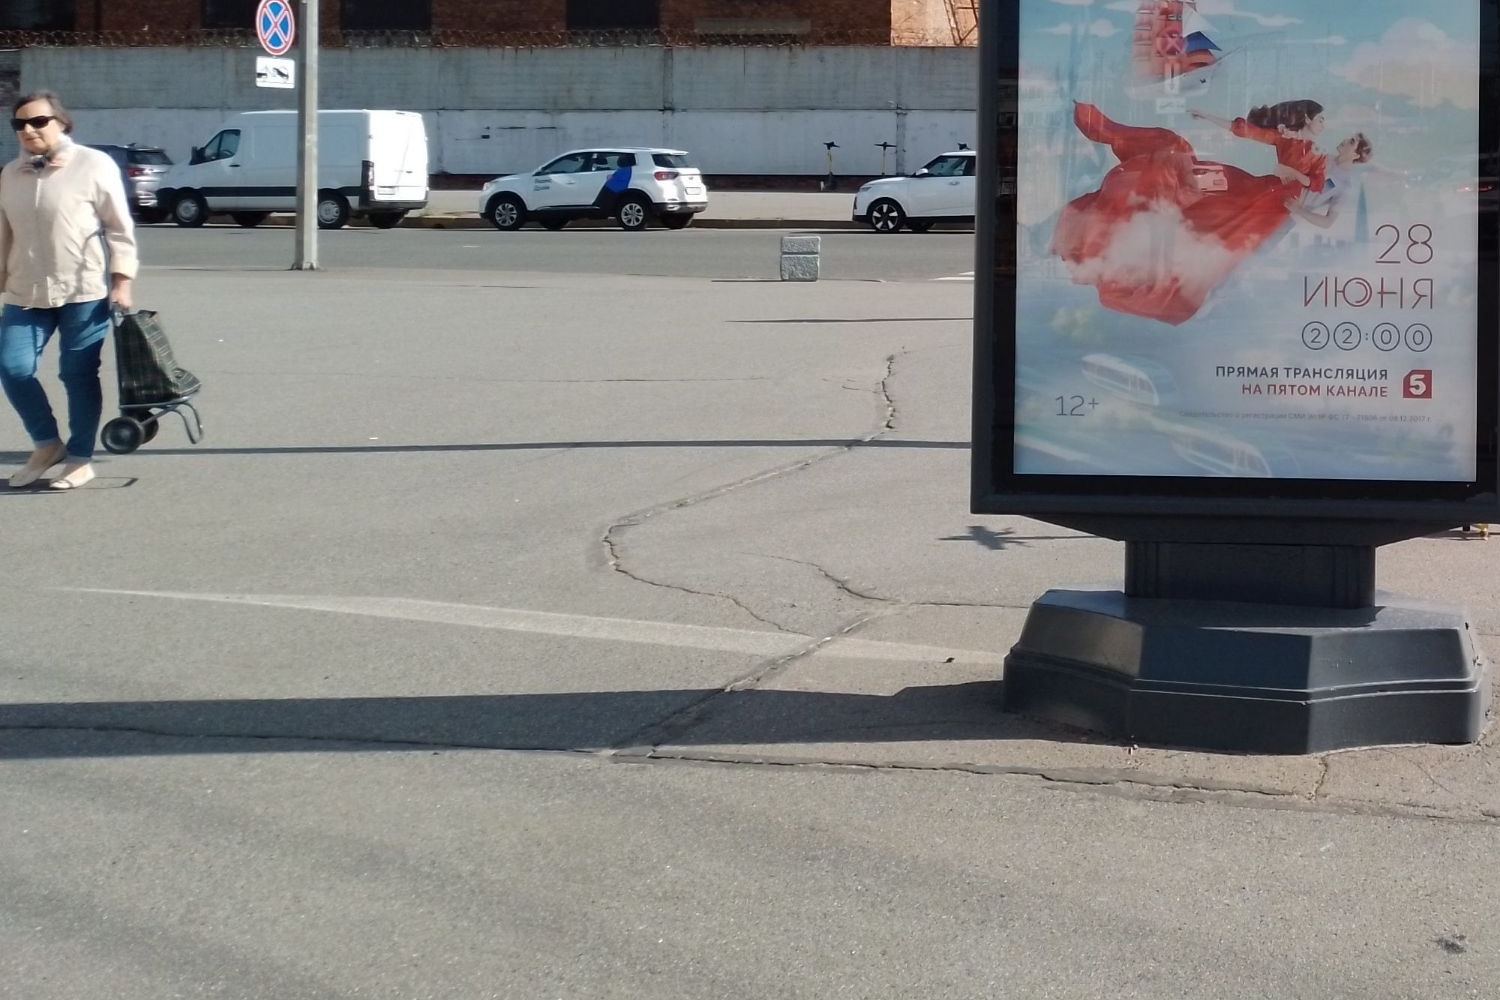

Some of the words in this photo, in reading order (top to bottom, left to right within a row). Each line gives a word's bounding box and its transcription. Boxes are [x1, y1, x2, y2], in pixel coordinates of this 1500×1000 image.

[1375, 224, 1434, 265] 28
[1303, 276, 1434, 310] ИЮНЯ
[1301, 321, 1433, 352] 22:00
[1215, 366, 1279, 379] ПРЯМАЯ
[1283, 366, 1388, 382] ТРАНСЛЯЦИЯ
[1242, 383, 1263, 396] НА
[1266, 384, 1321, 397] ПЯТОМ
[1326, 384, 1388, 398] КАНАЛЕ
[1055, 395, 1100, 417] 12+
